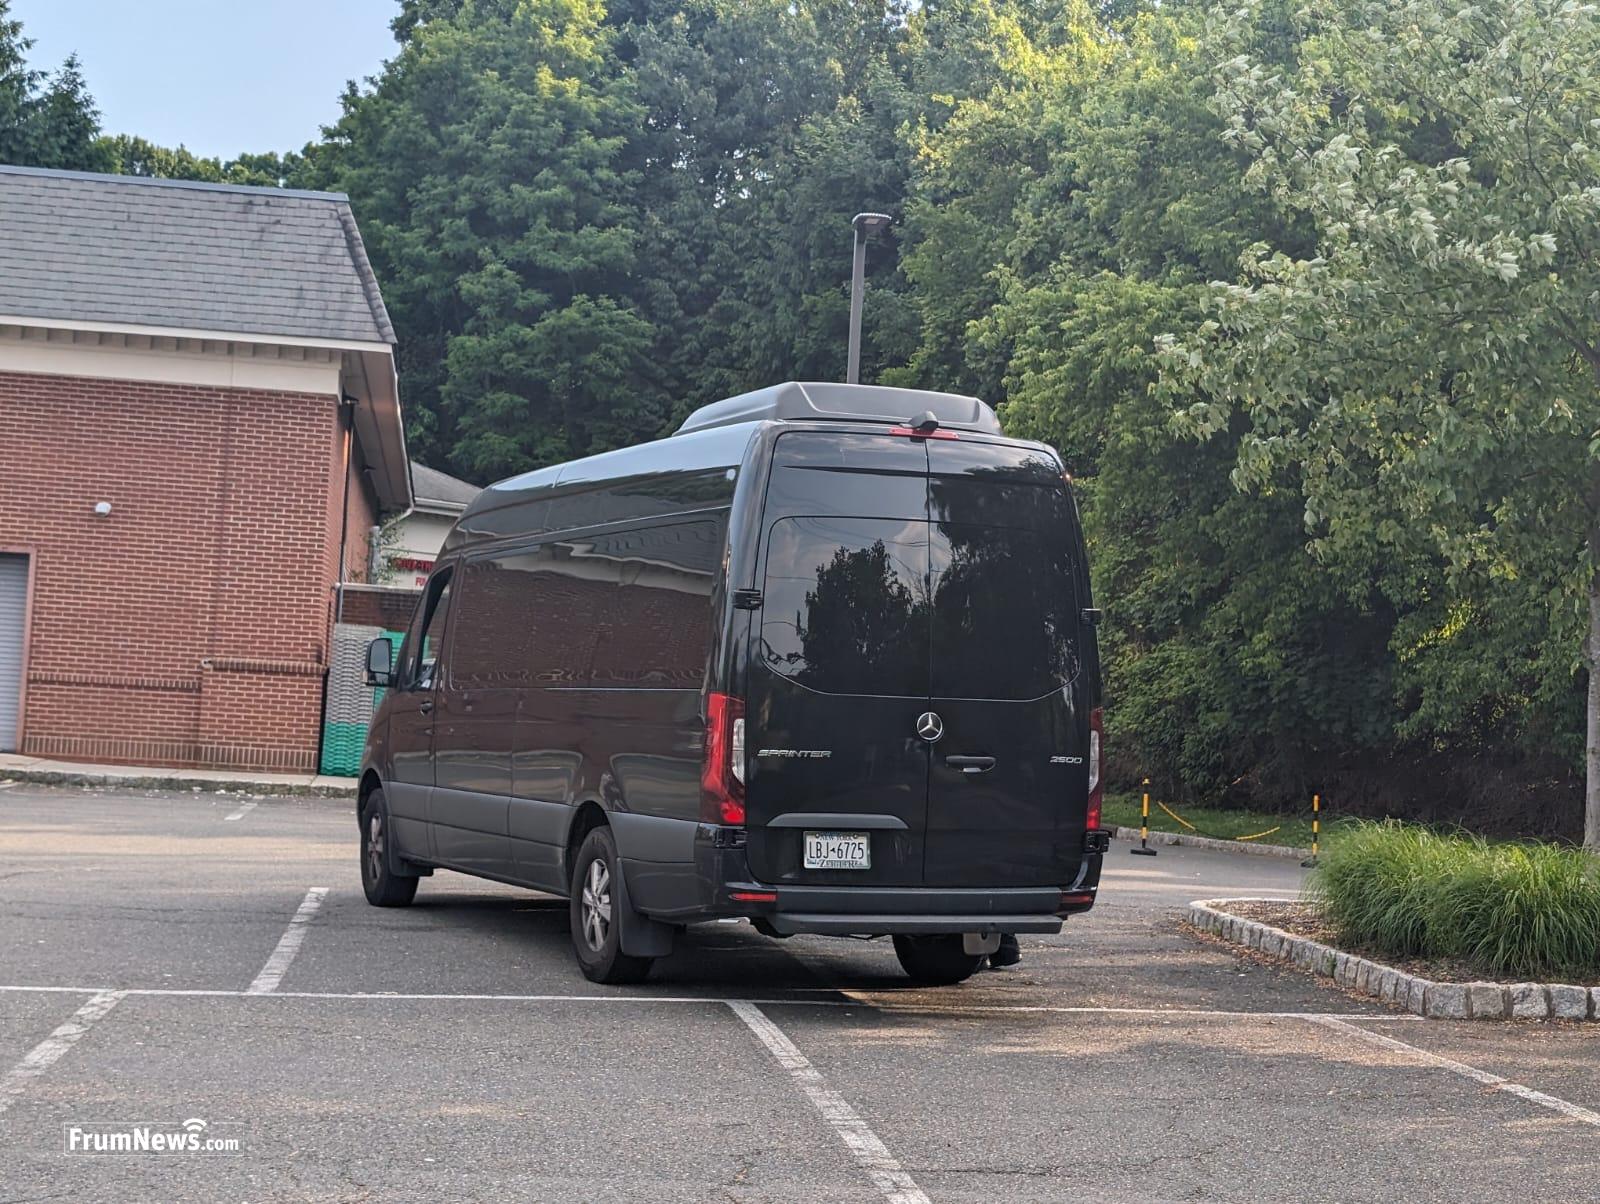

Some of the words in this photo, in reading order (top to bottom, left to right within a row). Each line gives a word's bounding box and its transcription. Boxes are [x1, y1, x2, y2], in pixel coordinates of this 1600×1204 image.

[757, 749, 833, 758] SPRINTER
[1050, 756, 1083, 764] 2500
[837, 842, 864, 859] 6725
